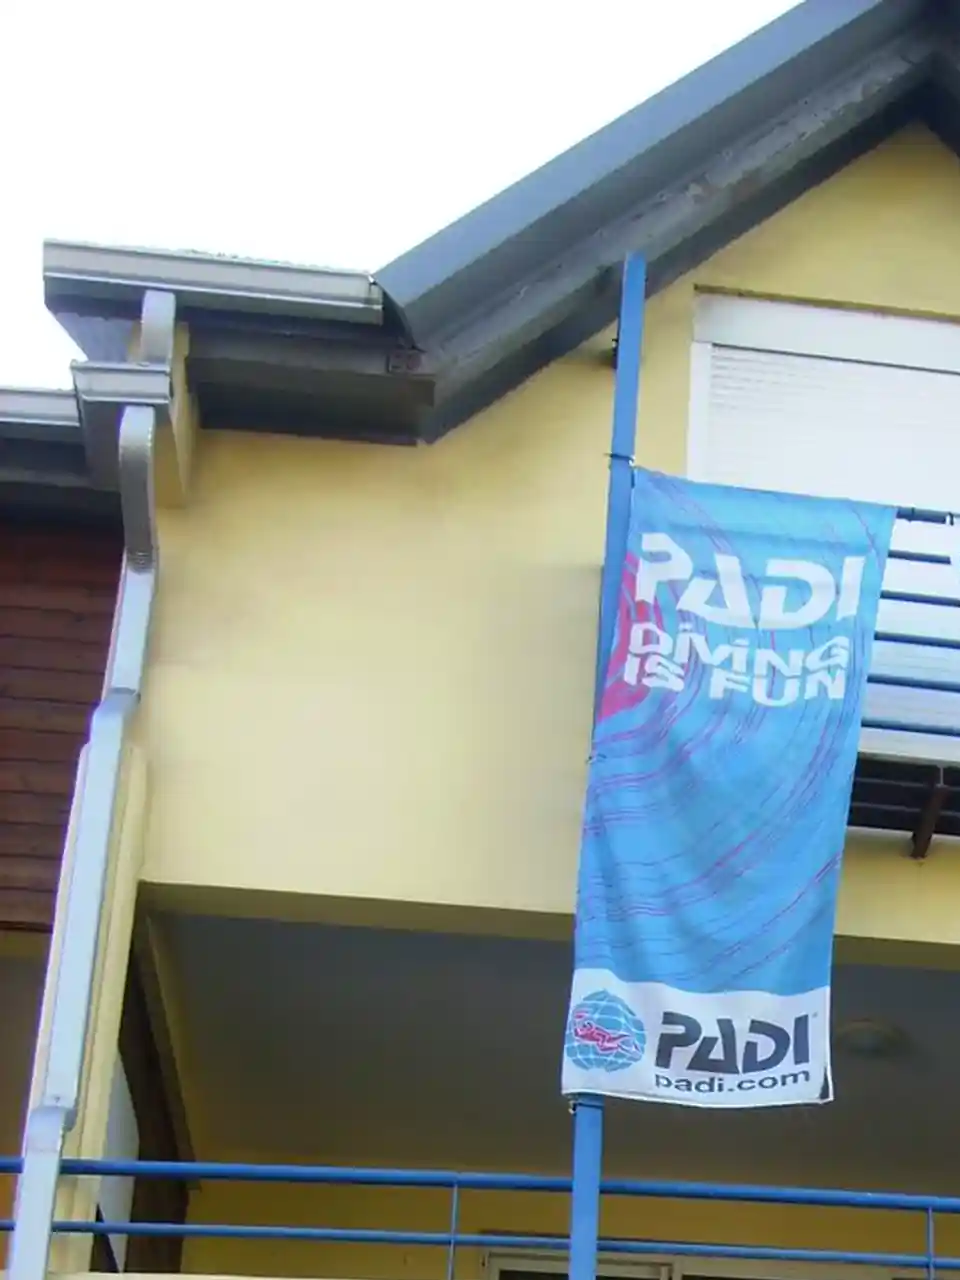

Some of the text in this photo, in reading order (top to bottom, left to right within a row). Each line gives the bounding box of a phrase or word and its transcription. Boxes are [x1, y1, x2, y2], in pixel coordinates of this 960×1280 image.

[635, 532, 866, 630] PADI
[624, 653, 846, 707] IS FUN
[655, 1011, 810, 1074] PADI
[655, 1069, 811, 1093] padi.com
